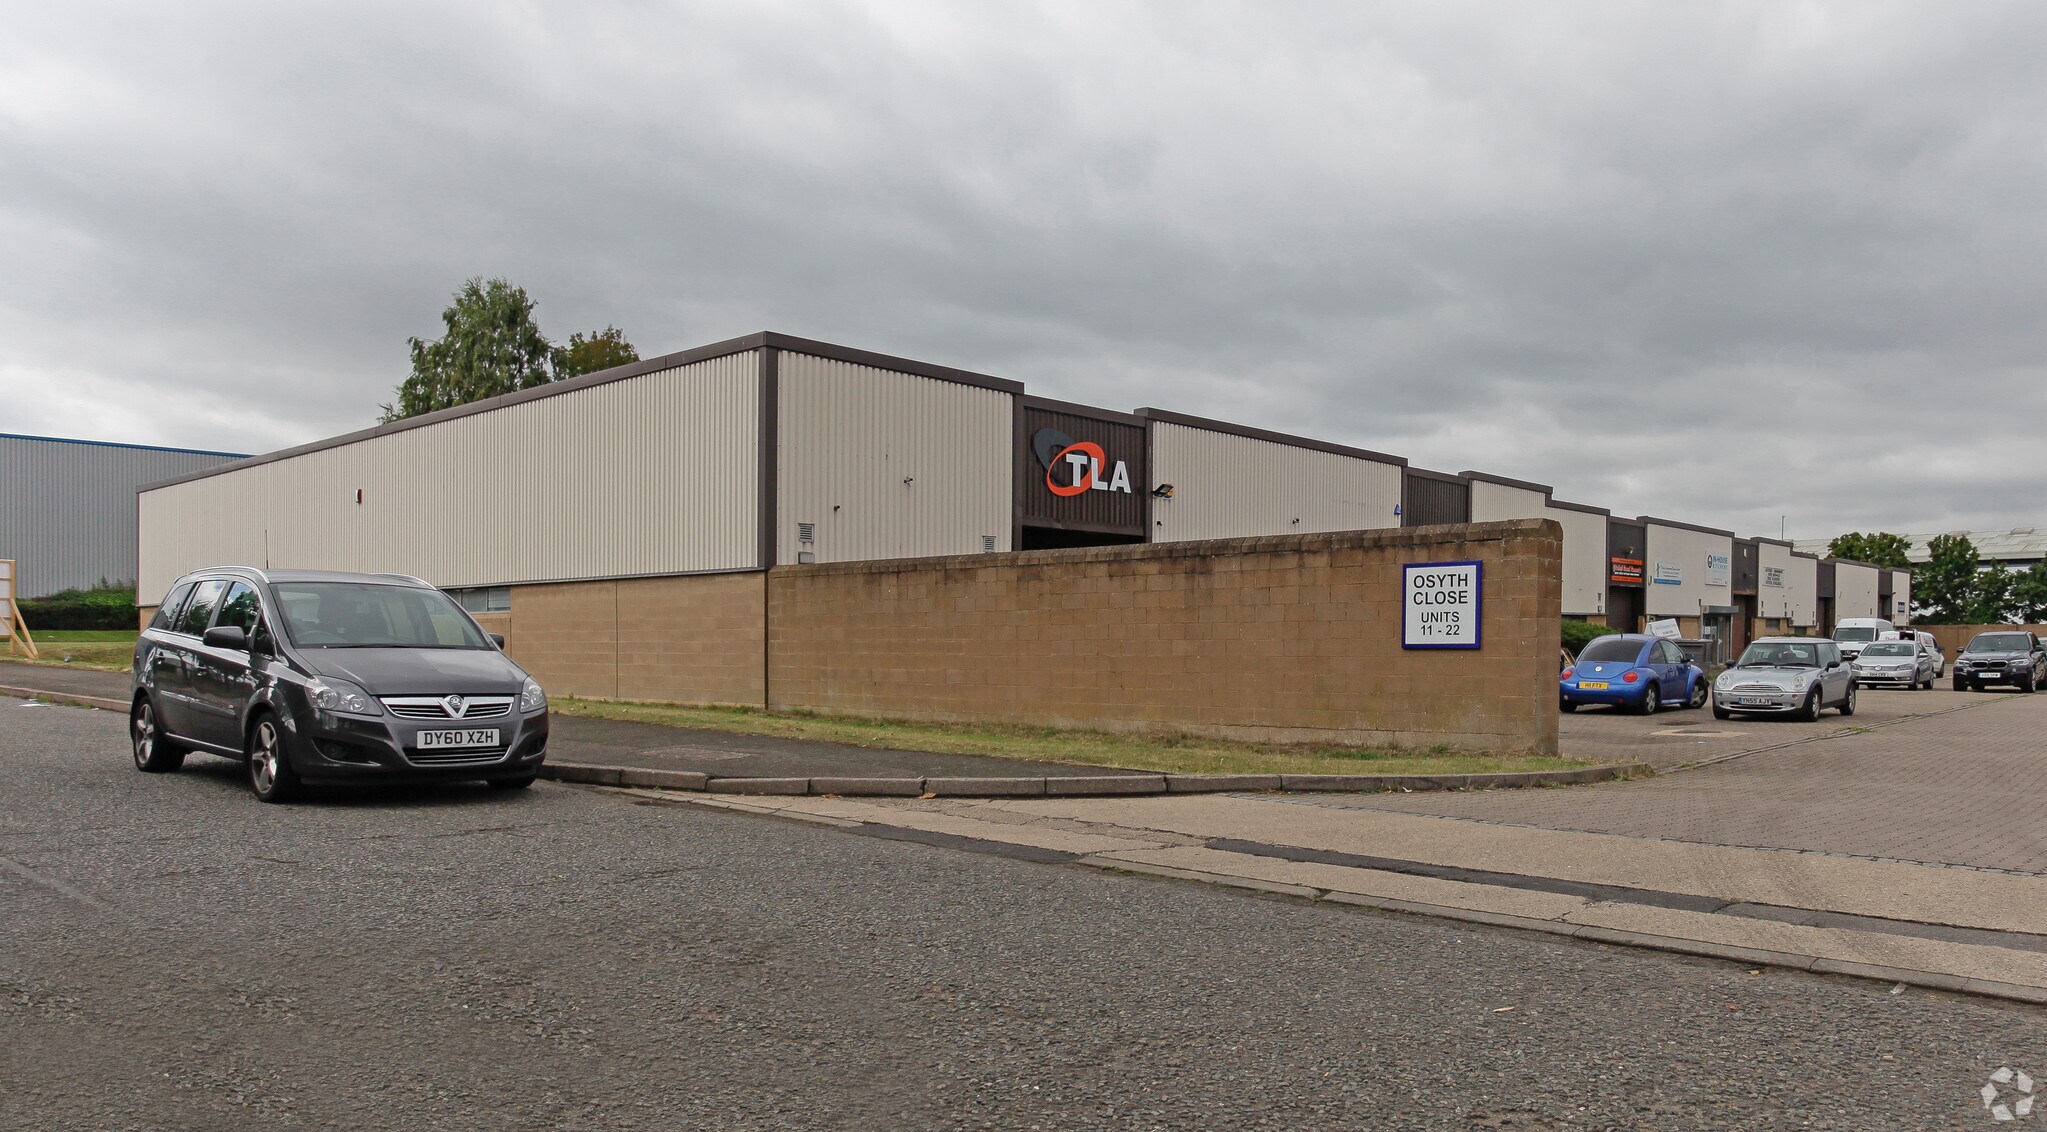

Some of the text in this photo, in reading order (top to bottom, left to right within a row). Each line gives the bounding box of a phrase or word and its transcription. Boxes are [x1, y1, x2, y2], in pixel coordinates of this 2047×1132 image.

[1065, 453, 1131, 494] TLA
[1413, 573, 1468, 588] OSYTH
[1413, 590, 1468, 605] CLOSE
[1421, 611, 1460, 623] UNITS
[1420, 624, 1432, 636] 11
[1445, 624, 1460, 636] 22
[424, 730, 494, 746] DY60 XZH
